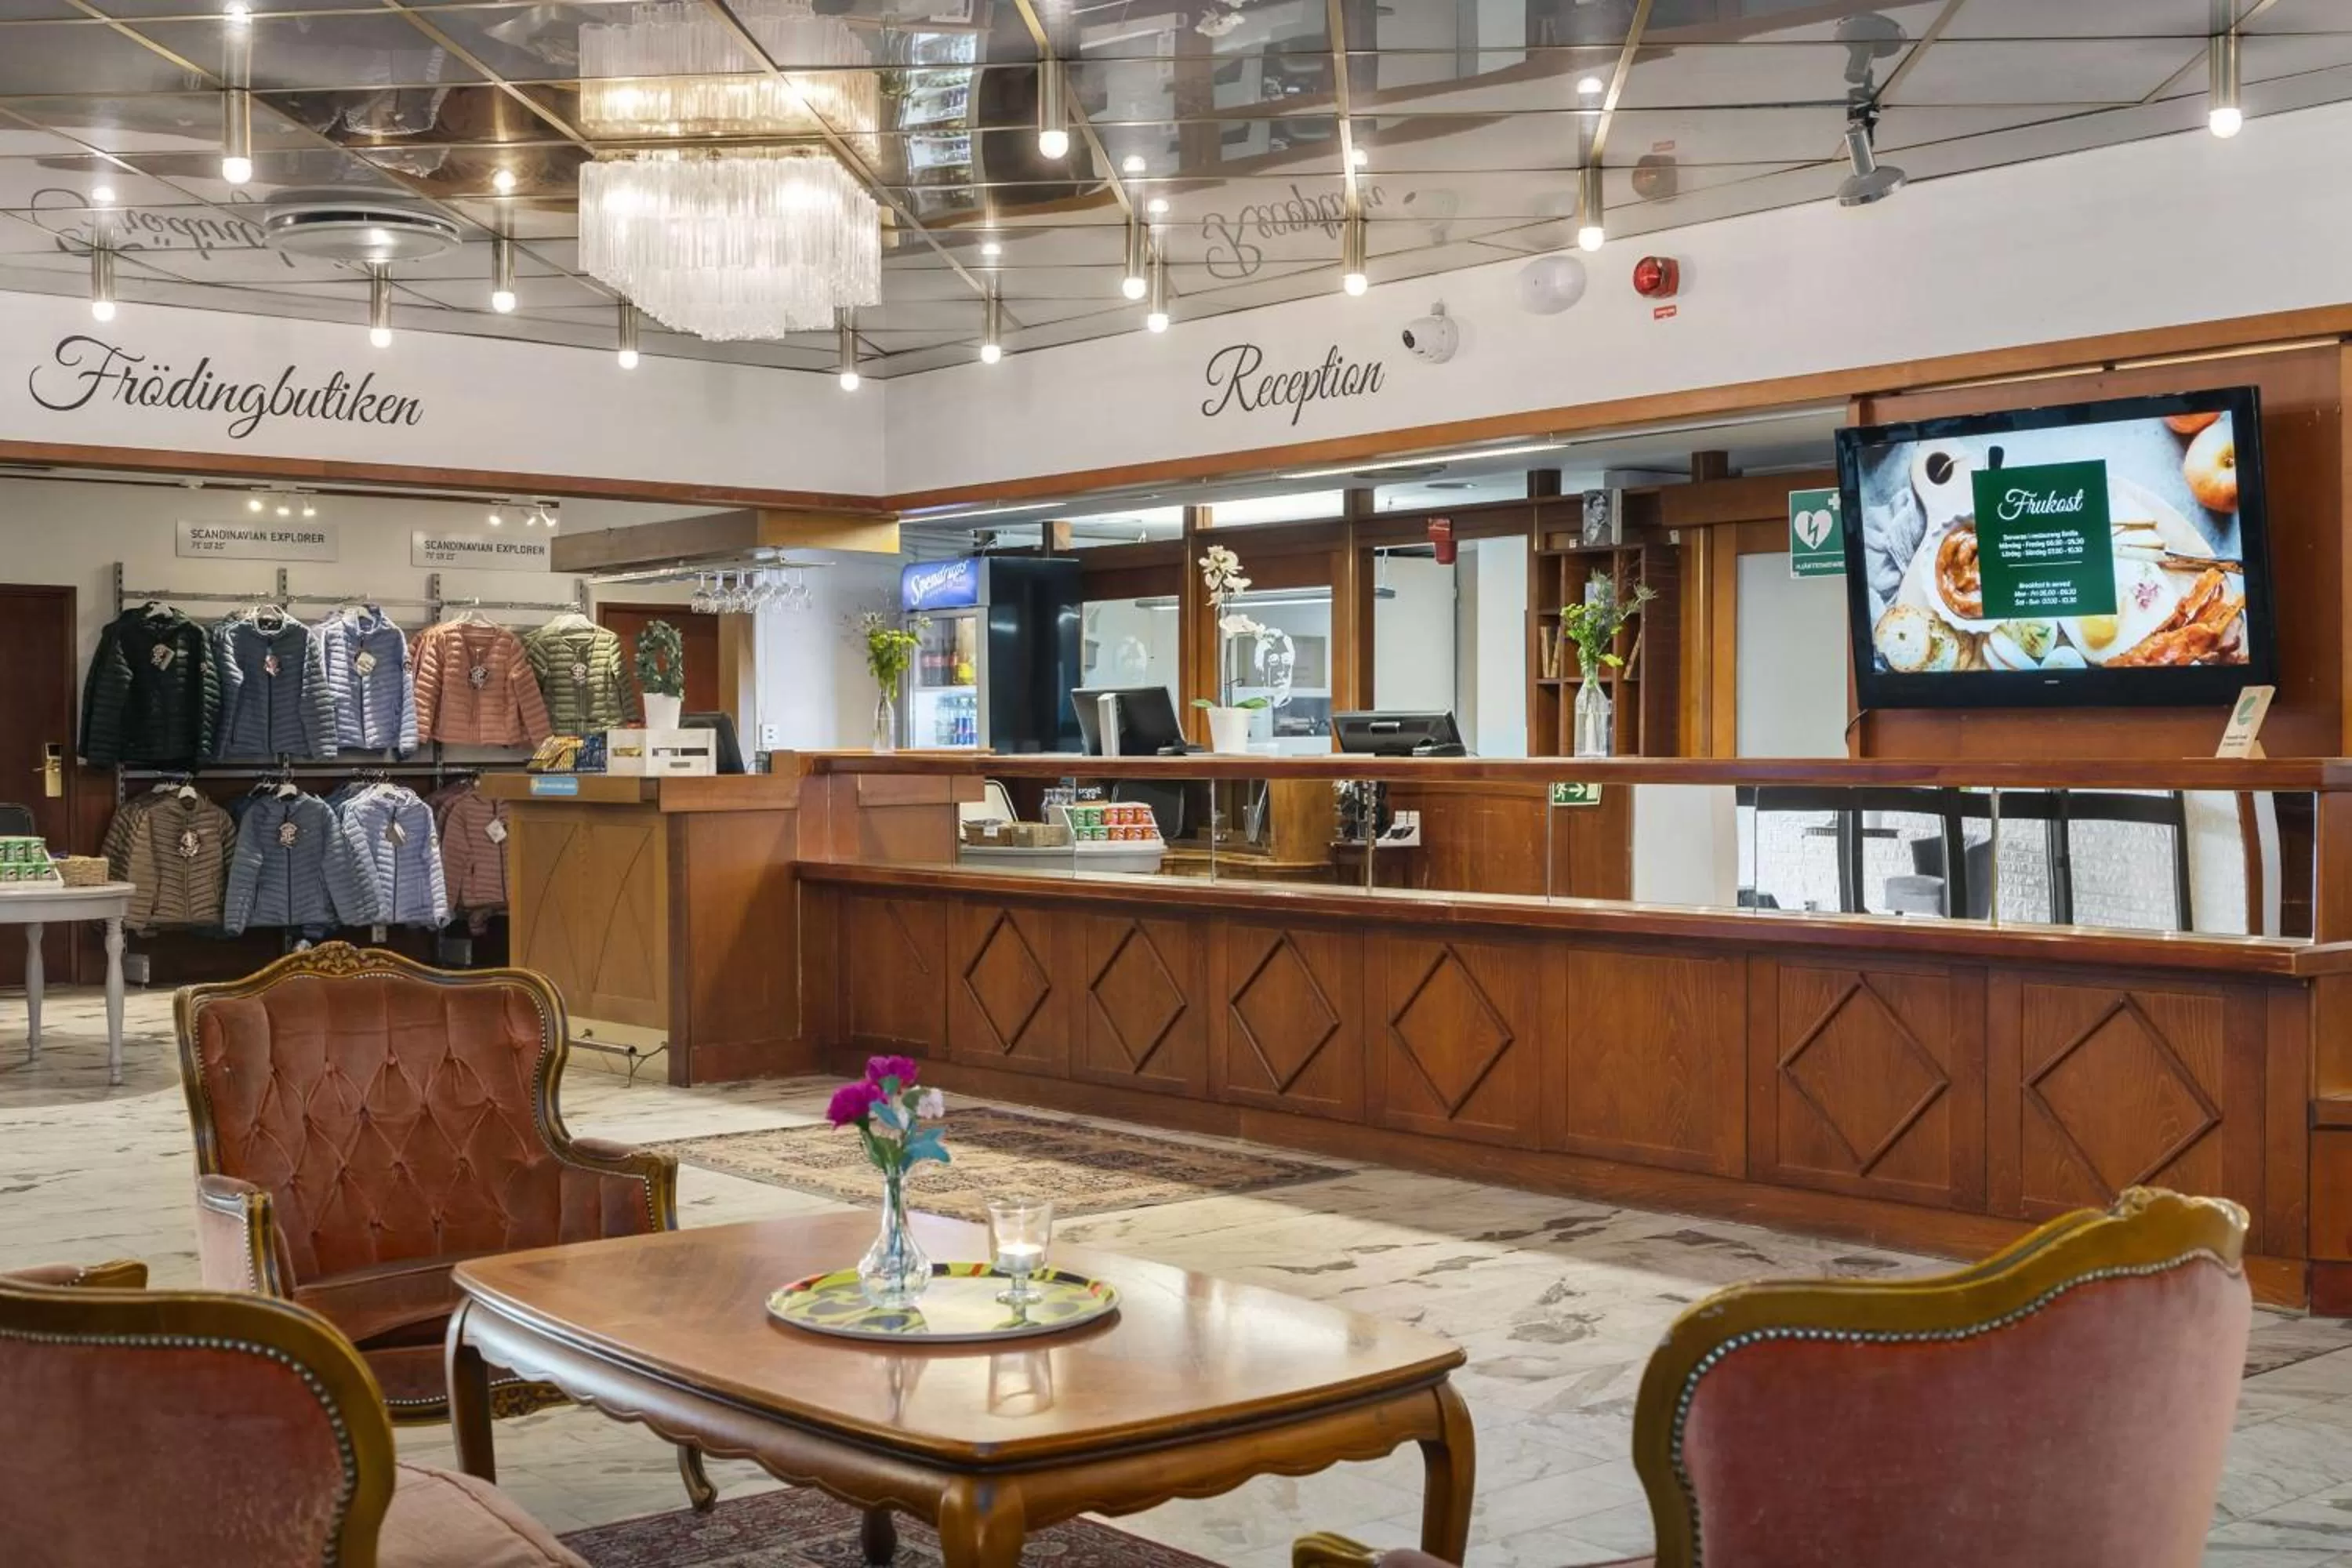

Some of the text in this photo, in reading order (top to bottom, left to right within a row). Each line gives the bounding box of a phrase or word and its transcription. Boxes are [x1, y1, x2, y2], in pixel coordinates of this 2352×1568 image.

[28, 335, 425, 440] Frödingbutiken
[1201, 343, 1385, 426] Reception
[1997, 488, 2085, 521] Frukost
[190, 528, 326, 544] SCANDINAVIAN EXPLORER
[424, 539, 545, 556] SCANDINAVIAN EXPLORER
